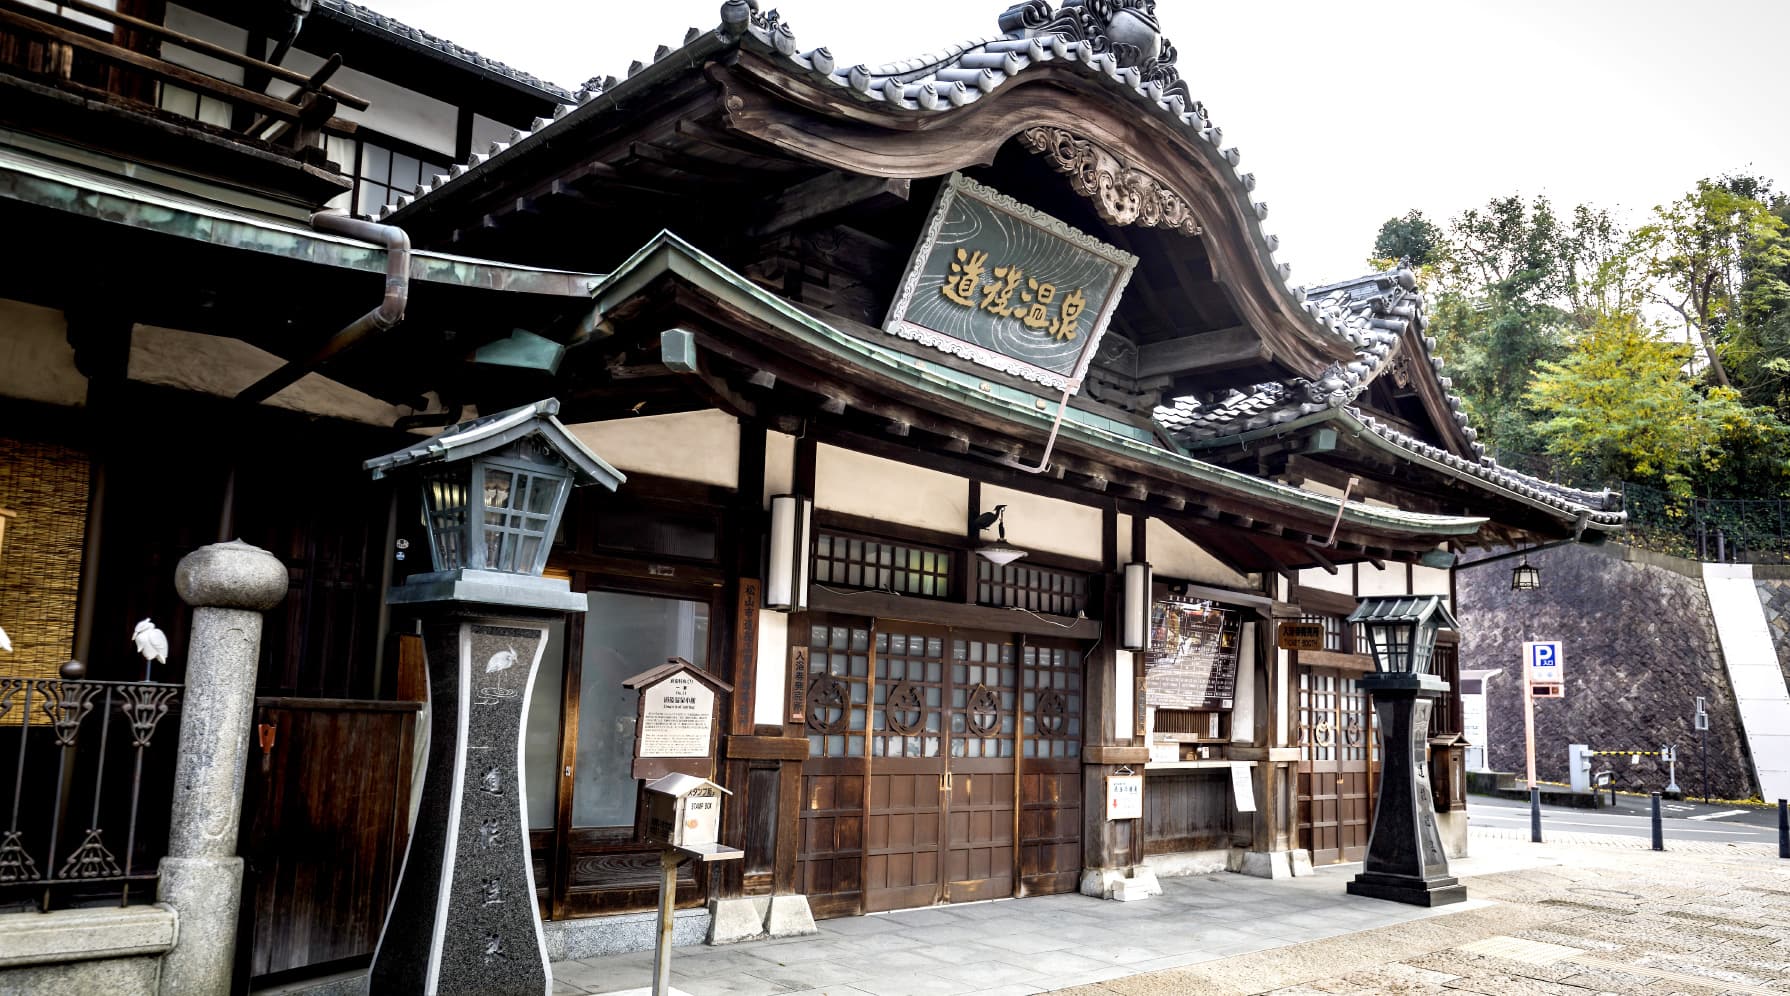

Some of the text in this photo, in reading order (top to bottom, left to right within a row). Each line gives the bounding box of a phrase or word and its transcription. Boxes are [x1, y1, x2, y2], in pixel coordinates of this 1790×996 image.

[942, 247, 1087, 341] 道後温泉
[1535, 645, 1553, 666] P
